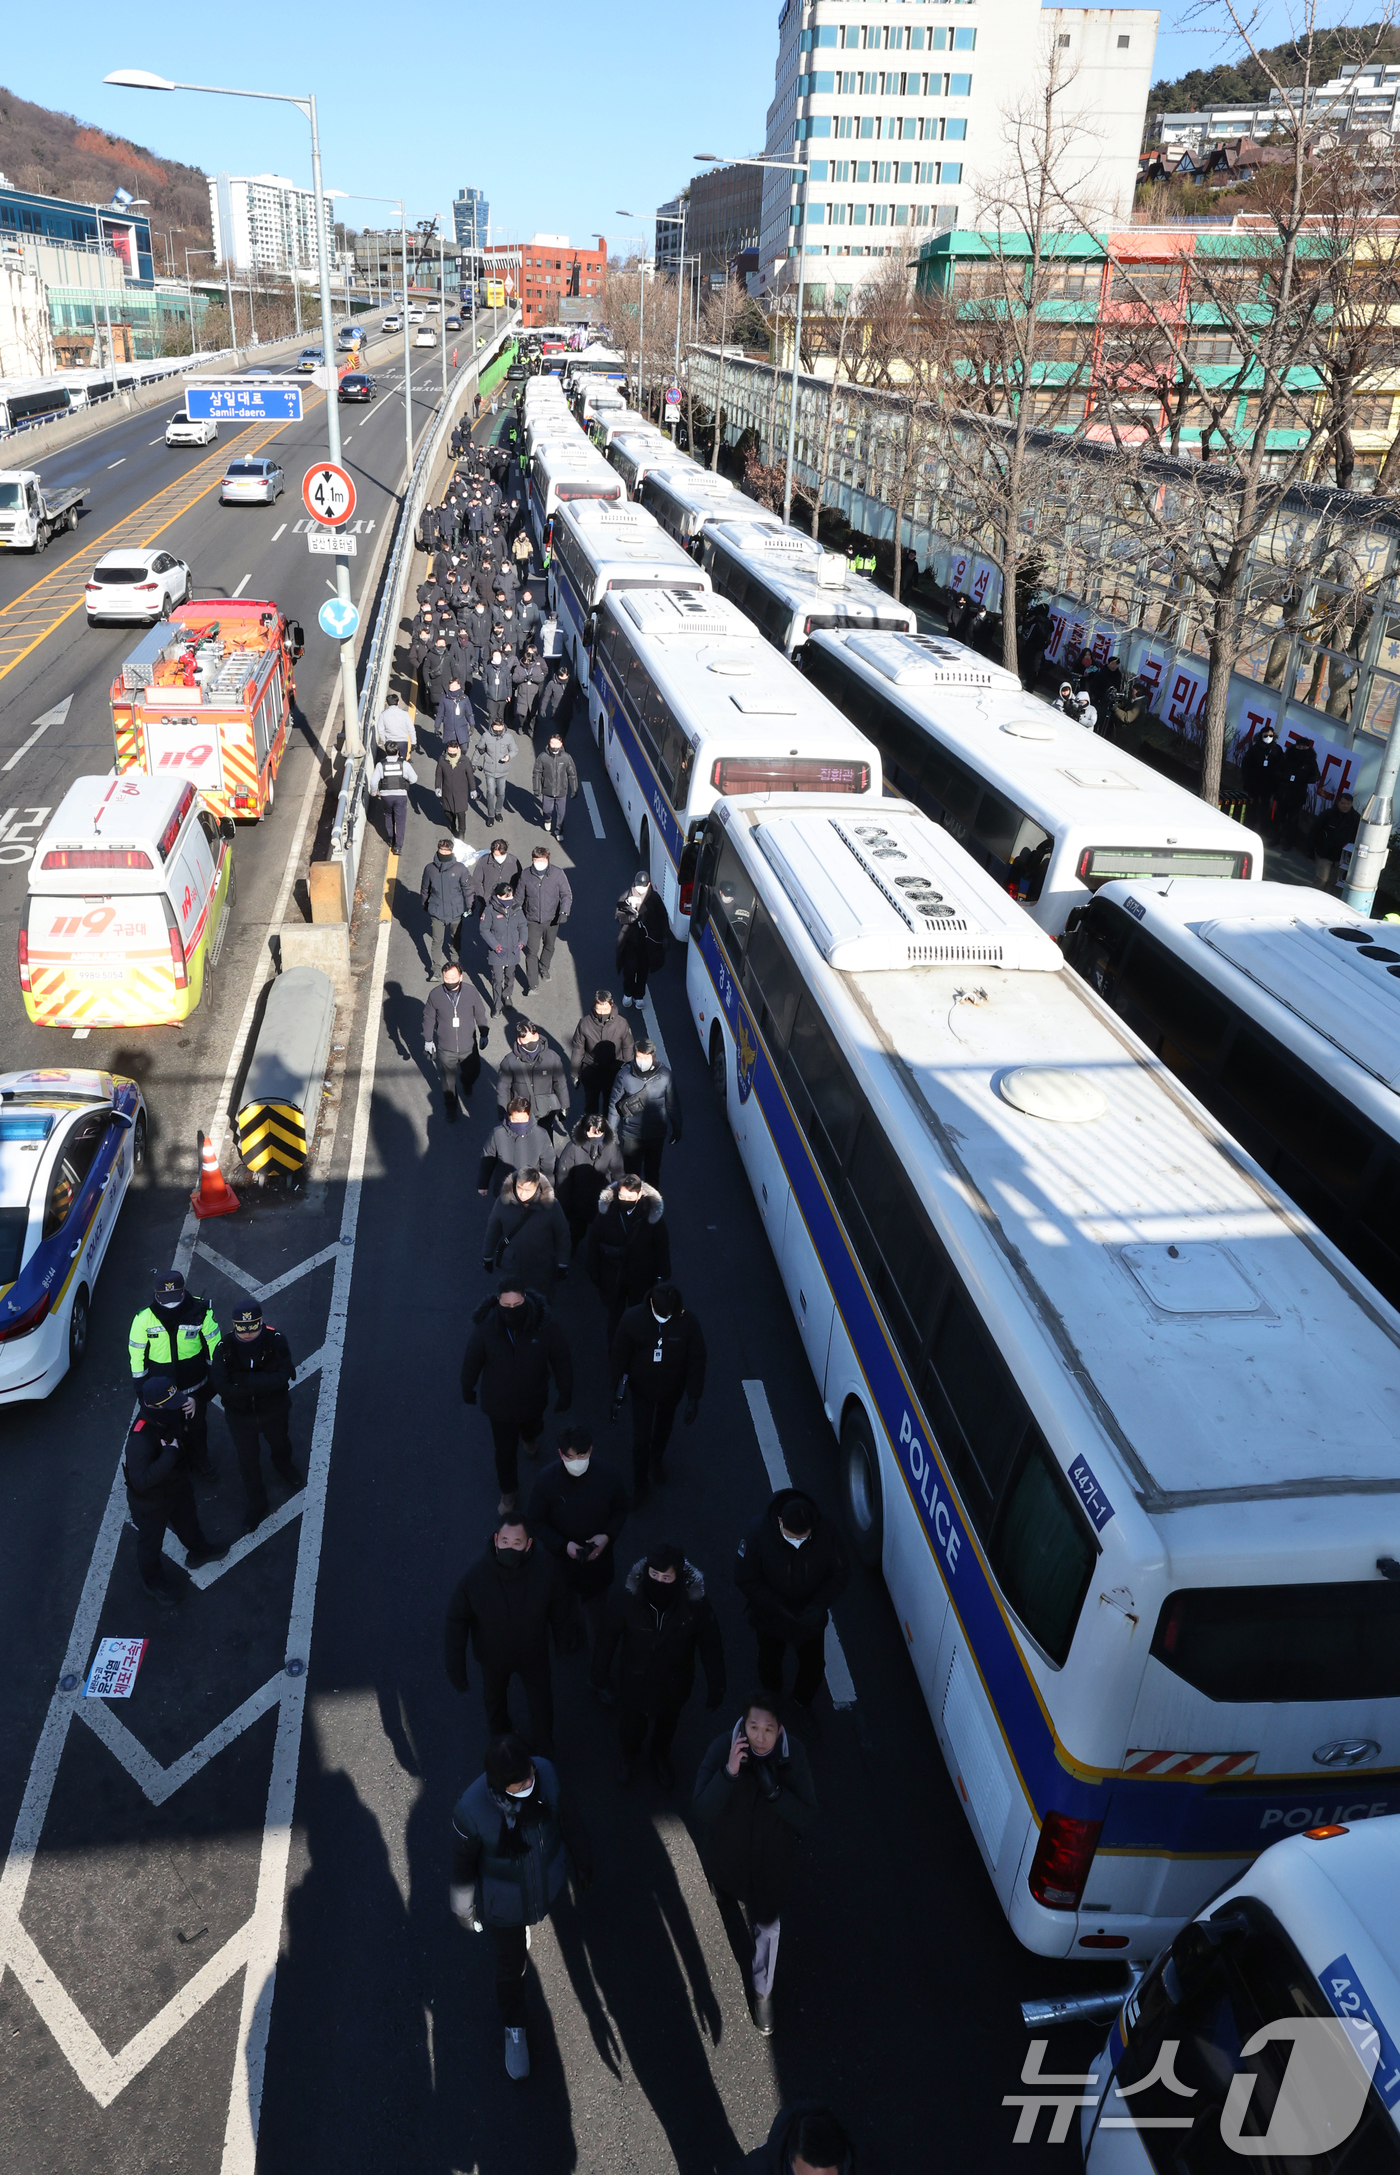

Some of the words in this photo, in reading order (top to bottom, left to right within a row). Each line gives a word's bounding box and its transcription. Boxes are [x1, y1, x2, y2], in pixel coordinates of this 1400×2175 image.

[209, 391, 265, 407] 삼일대로
[283, 392, 297, 401] 476
[209, 407, 266, 417] Samil-daero
[288, 409, 294, 417] 2
[291, 519, 377, 534] 대차
[157, 744, 214, 769] 119
[653, 789, 668, 832] POLICE
[181, 885, 193, 923] 119
[47, 906, 117, 938] 119
[112, 922, 147, 936] 구급대
[102, 971, 123, 980] 5054
[86, 1218, 103, 1269] POLICE
[899, 1409, 961, 1575] POLICE
[1073, 1466, 1107, 1520] 44기-1
[97, 1659, 121, 1694] 윤석열
[1259, 1801, 1389, 1830] POLICE
